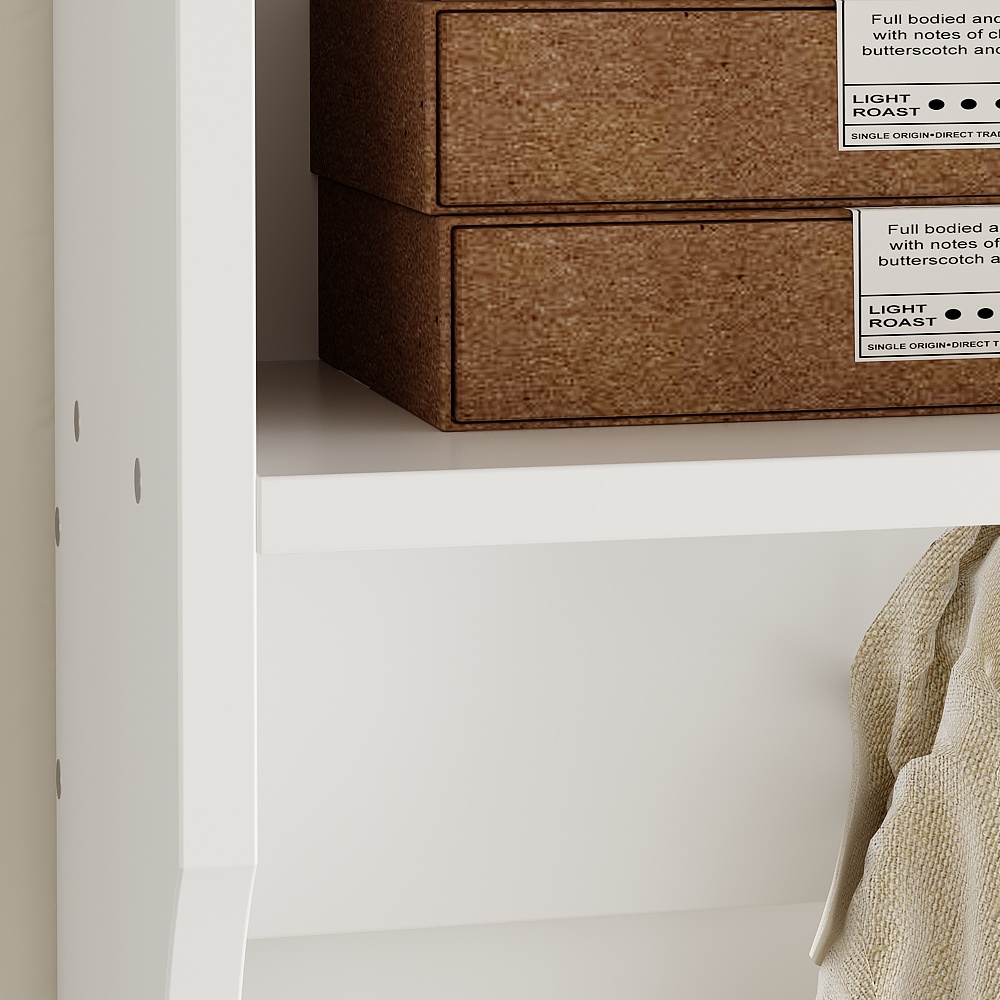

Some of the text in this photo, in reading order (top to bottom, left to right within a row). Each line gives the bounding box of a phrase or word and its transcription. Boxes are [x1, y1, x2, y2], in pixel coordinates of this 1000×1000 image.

[872, 13, 901, 25] Full
[909, 13, 965, 25] bodied
[873, 29, 906, 41] with
[915, 29, 960, 40] notes
[967, 28, 983, 40] of
[863, 44, 967, 56] butterscotch
[853, 93, 910, 104] LIGHT
[853, 107, 920, 118] ROAST
[852, 132, 889, 140] SINGLE
[889, 223, 918, 235] Full
[925, 222, 982, 235] bodied
[890, 239, 923, 251] with
[931, 239, 977, 250] notes
[984, 237, 1000, 249] of
[879, 254, 983, 267] butterscotch
[870, 303, 927, 315] LIGHT
[870, 317, 937, 328] ROAST
[868, 342, 906, 351] SINGLE
